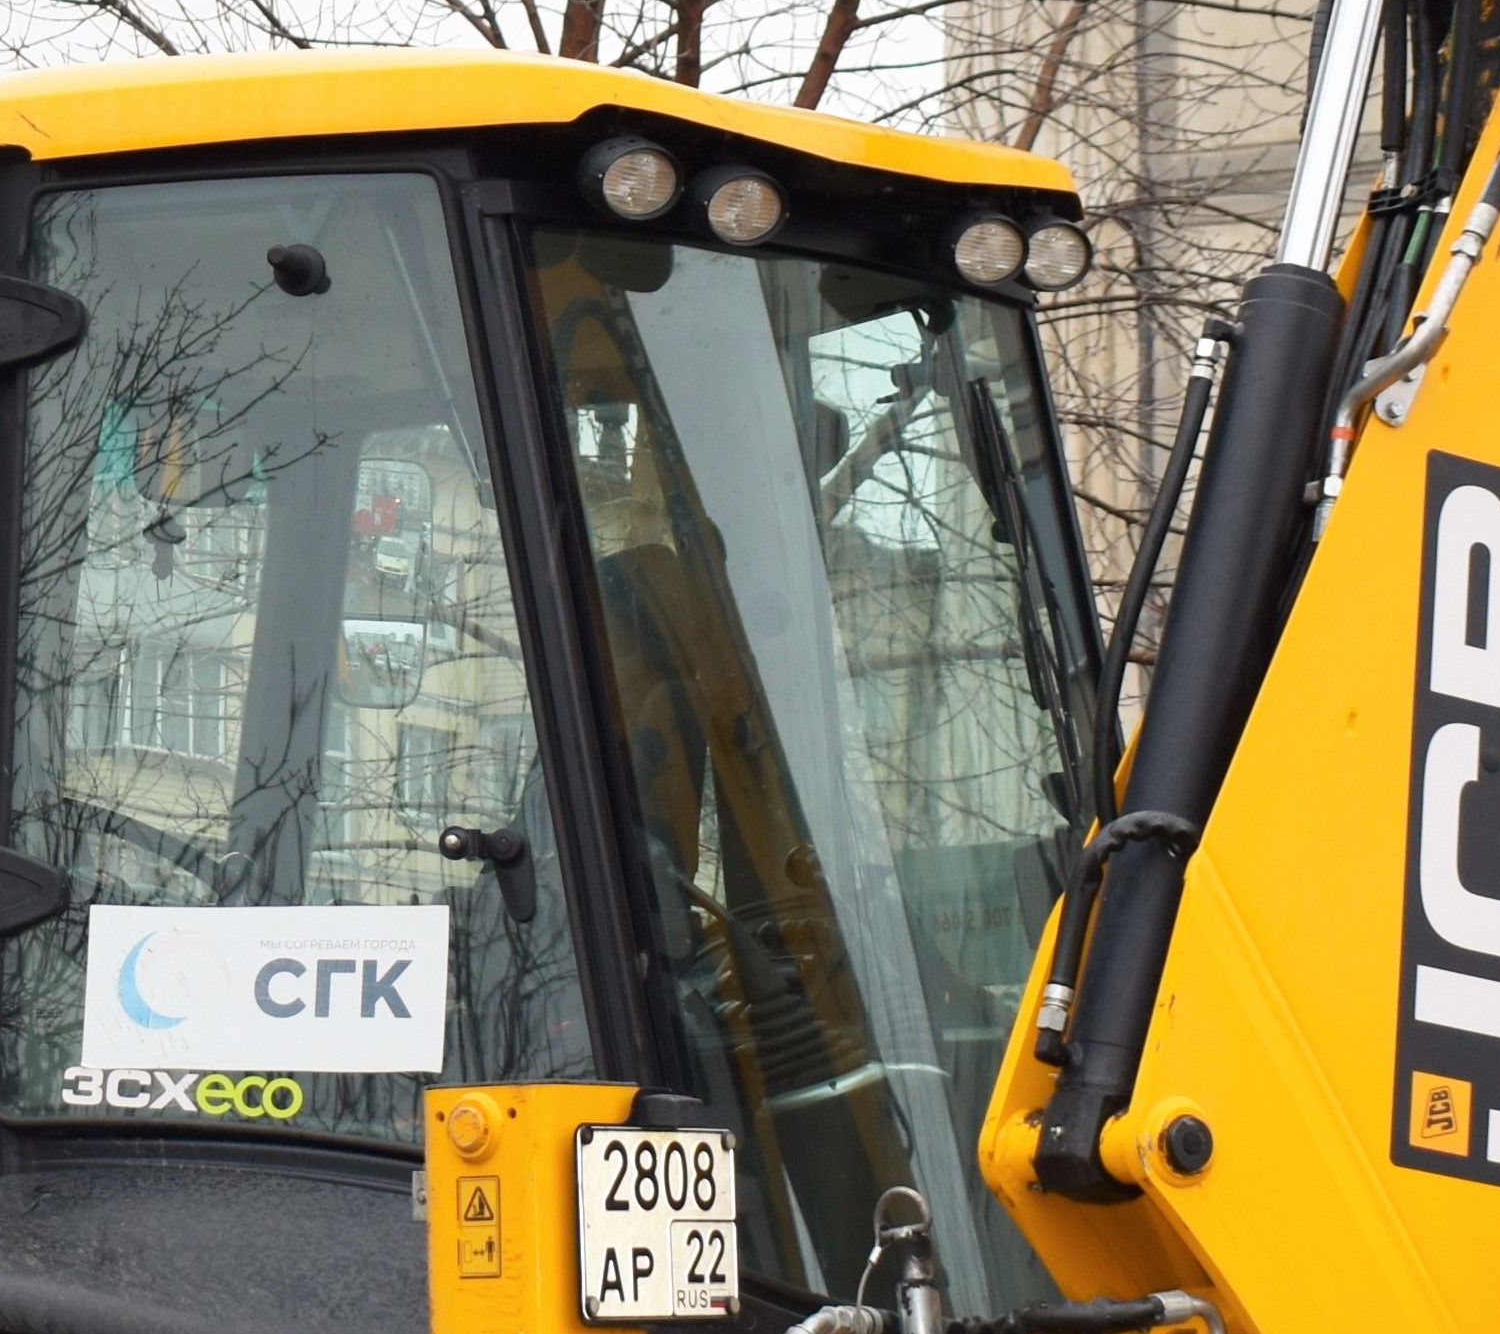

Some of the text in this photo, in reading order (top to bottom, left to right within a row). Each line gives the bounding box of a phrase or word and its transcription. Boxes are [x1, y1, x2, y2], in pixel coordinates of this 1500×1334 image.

[260, 939, 416, 952] МЫ СОГРЕВАЕМ ГОРОДА
[254, 957, 413, 1018] СГК
[1427, 1090, 1452, 1131] JCB
[604, 1139, 716, 1211] 2808
[686, 1229, 726, 1283] 22
[676, 1289, 708, 1309] RUS
